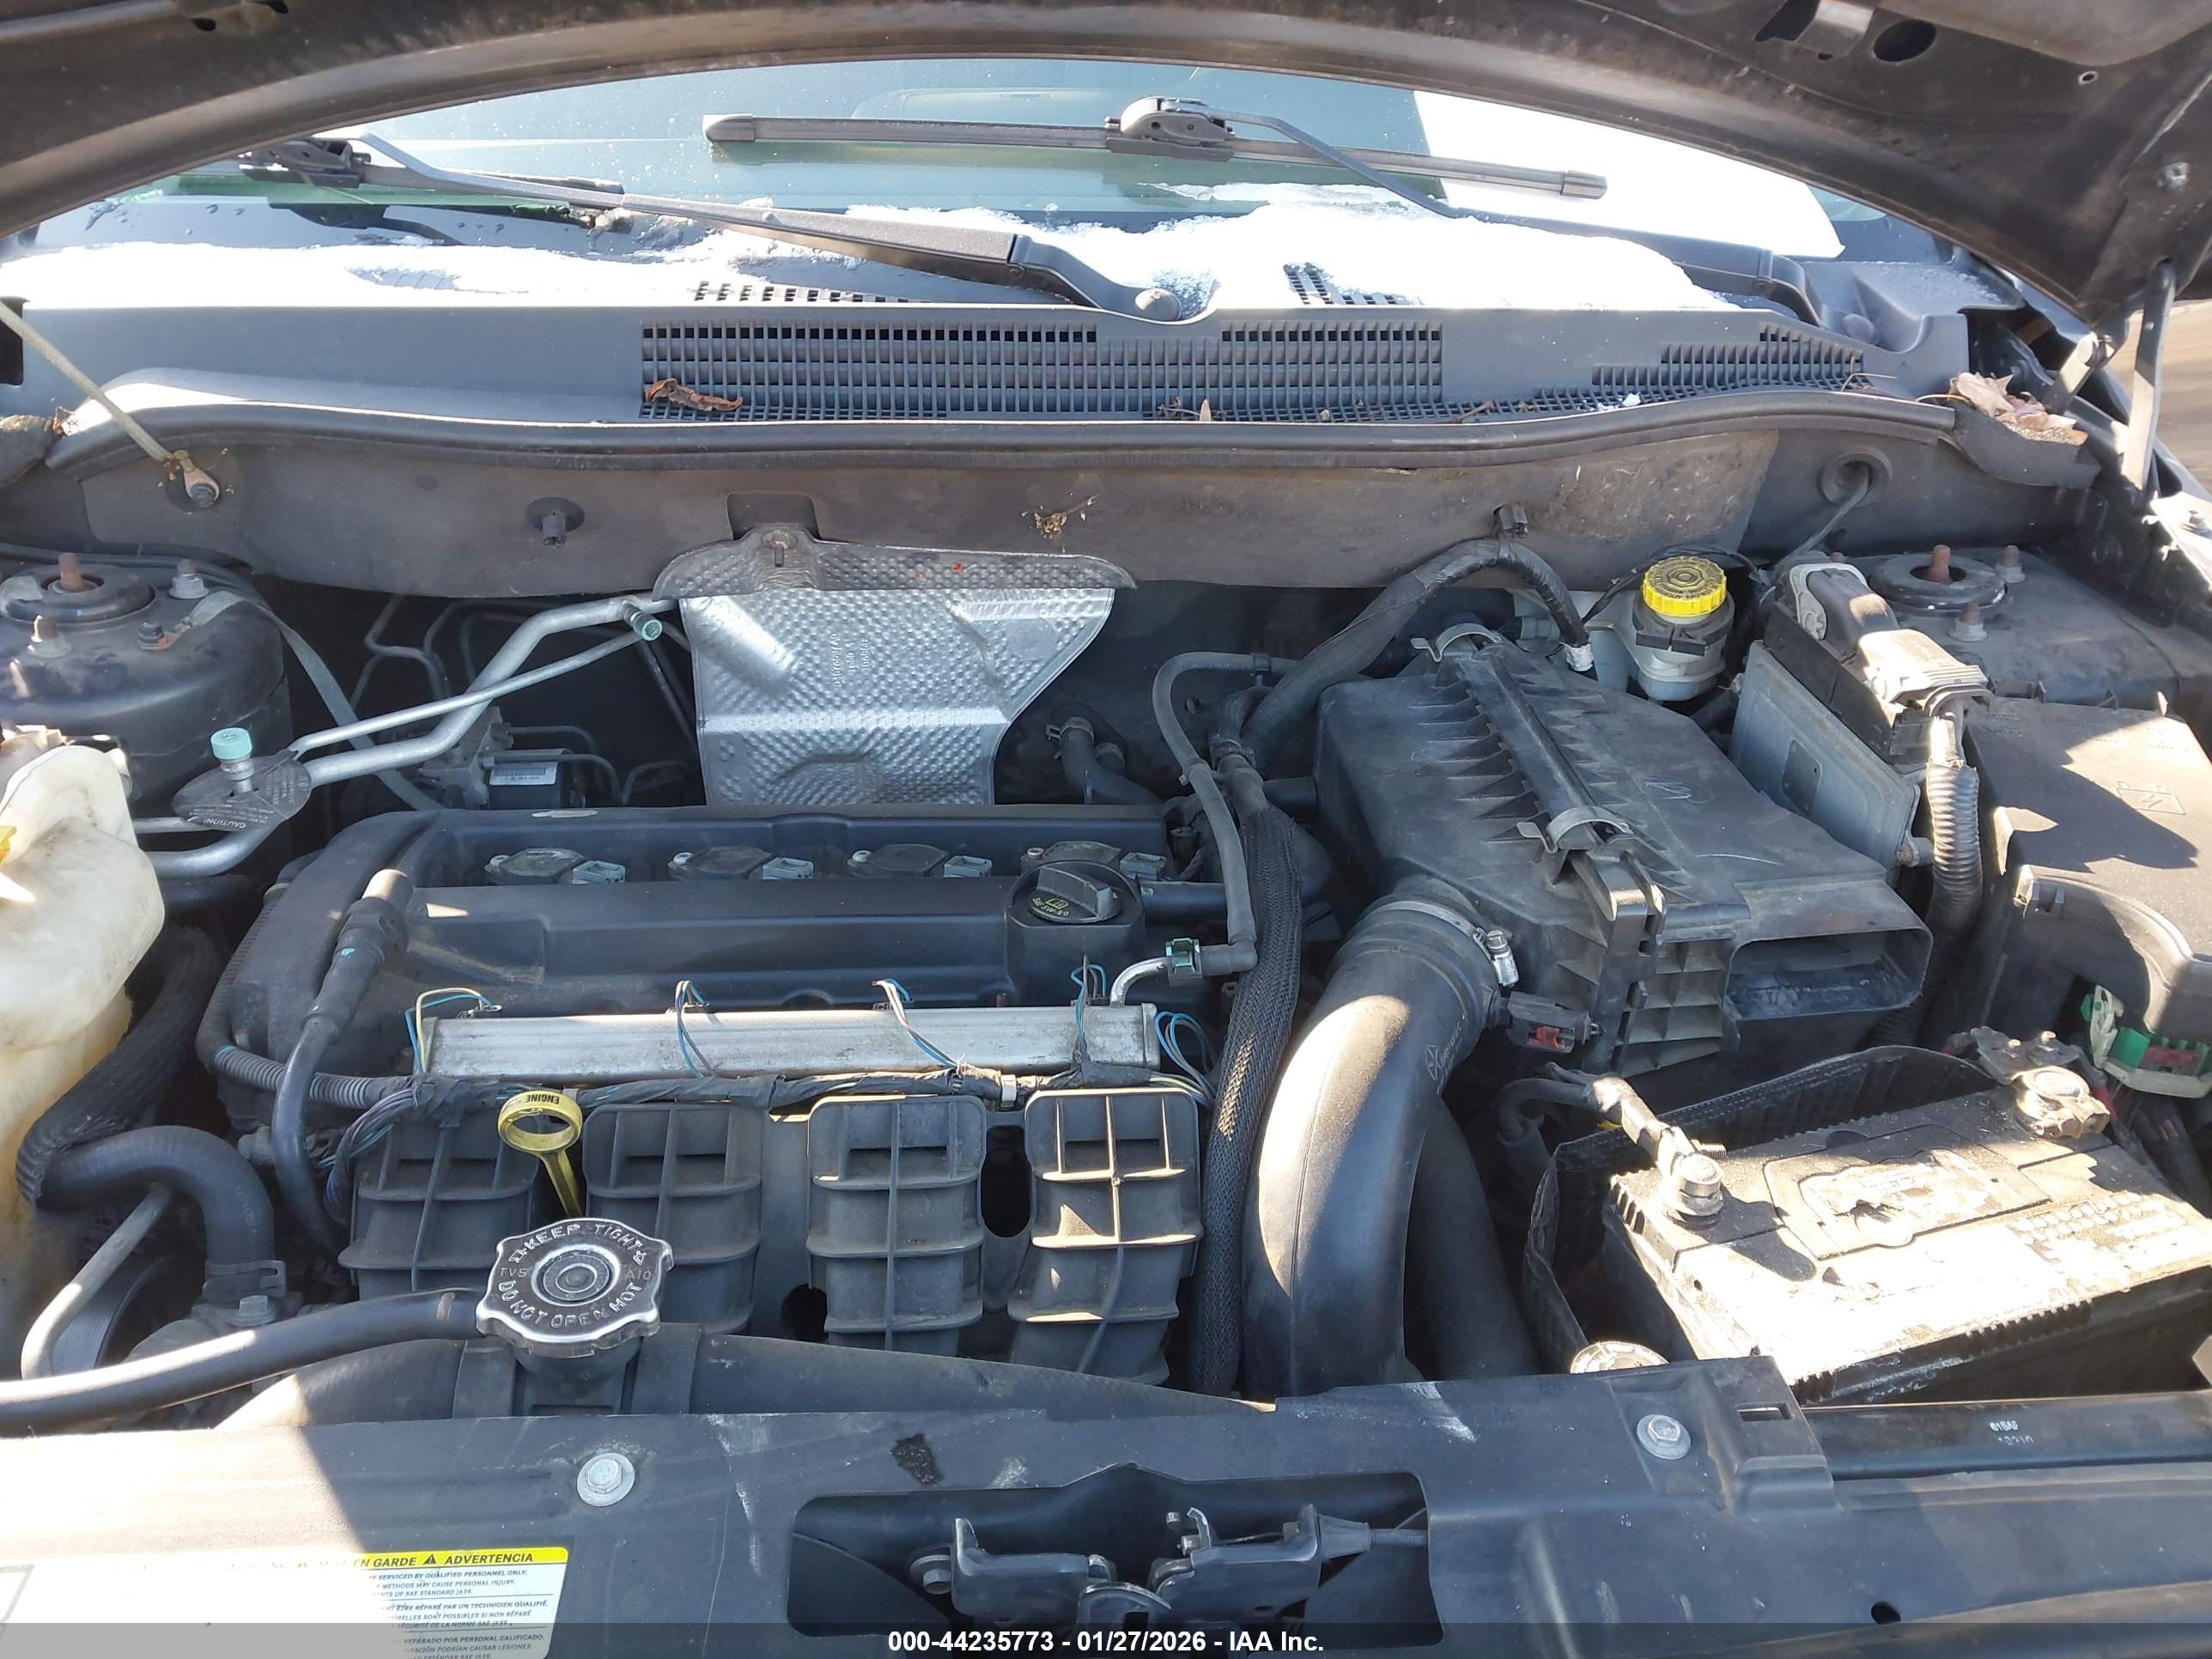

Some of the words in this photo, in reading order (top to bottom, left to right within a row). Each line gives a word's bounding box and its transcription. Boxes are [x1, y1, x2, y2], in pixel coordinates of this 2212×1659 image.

[203, 817, 246, 829] CAUTION!
[526, 1093, 560, 1105] ENGINE
[524, 1224, 580, 1250] KEEP
[594, 1224, 644, 1250] TIGHT
[499, 1267, 528, 1278] TVS
[498, 1280, 517, 1302] DO
[510, 1300, 548, 1324] NOT
[550, 1309, 610, 1328] OPEN
[609, 1282, 642, 1312] HOT
[373, 1557, 417, 1567] GARDE
[444, 1553, 533, 1565] ADVERTENCIA
[437, 1644, 469, 1653] PODRÍAN
